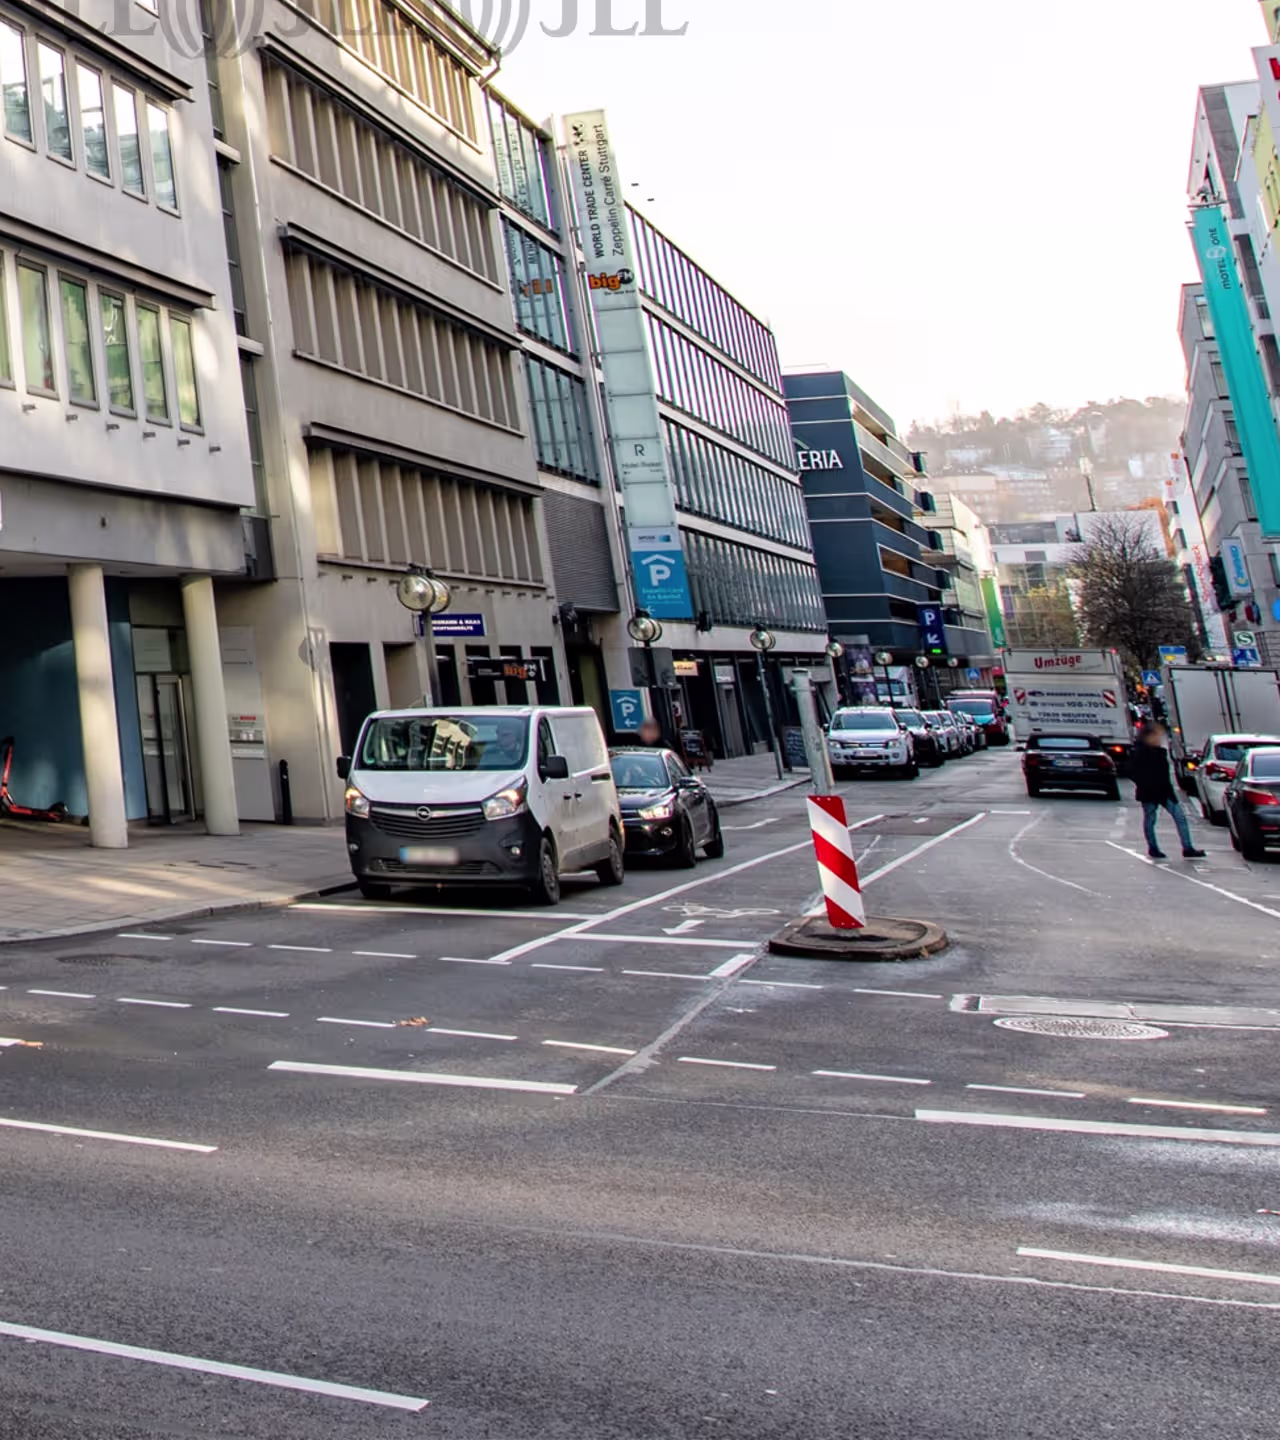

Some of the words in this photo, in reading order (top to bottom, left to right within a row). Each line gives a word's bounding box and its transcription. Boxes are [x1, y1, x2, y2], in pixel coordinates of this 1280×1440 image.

[593, 123, 610, 173] Stuttgart
[578, 149, 592, 188] CENTER
[584, 188, 599, 224] TRADE
[603, 175, 616, 206] Carré
[591, 223, 605, 259] WORLD
[606, 208, 625, 257] Zeppelin
[1217, 258, 1232, 290] MOTEL
[797, 449, 844, 470] ERIA
[649, 564, 671, 586] P
[924, 611, 936, 626] P
[1034, 655, 1082, 669] Umzüge
[621, 703, 635, 717] P
